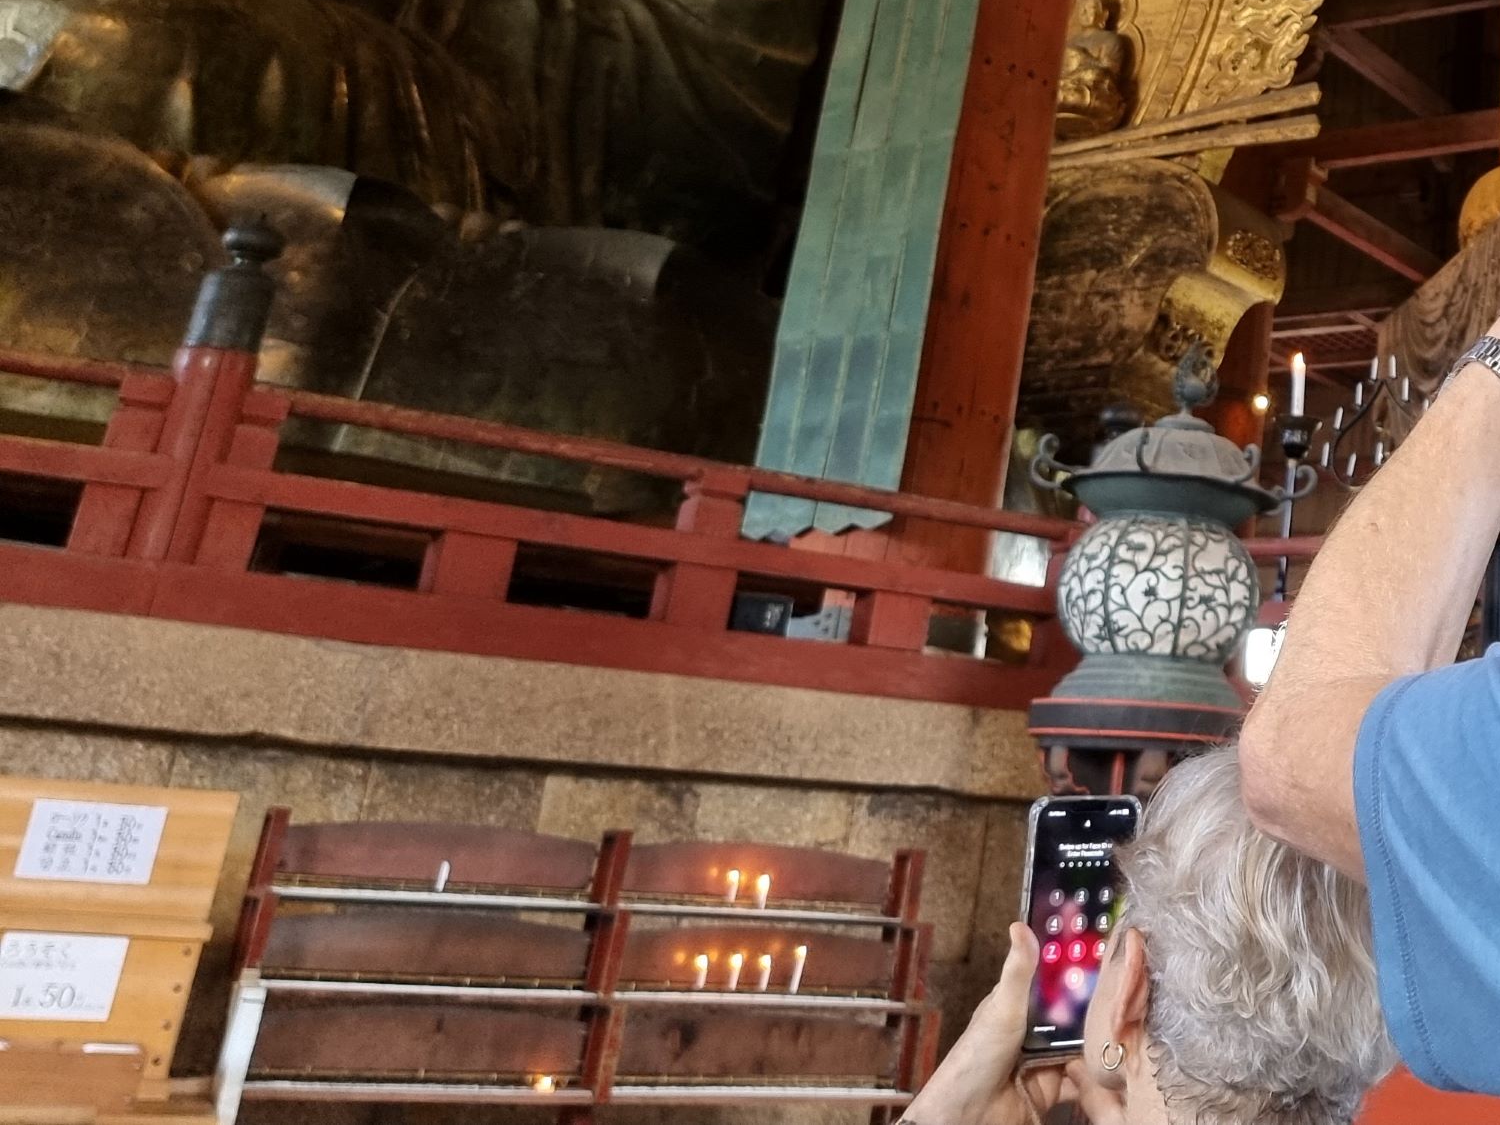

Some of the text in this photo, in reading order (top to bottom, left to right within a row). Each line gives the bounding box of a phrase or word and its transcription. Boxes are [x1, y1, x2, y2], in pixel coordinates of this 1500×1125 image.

[1051, 915, 1107, 927] 4 5 6
[1049, 942, 1106, 955] 7 8 9
